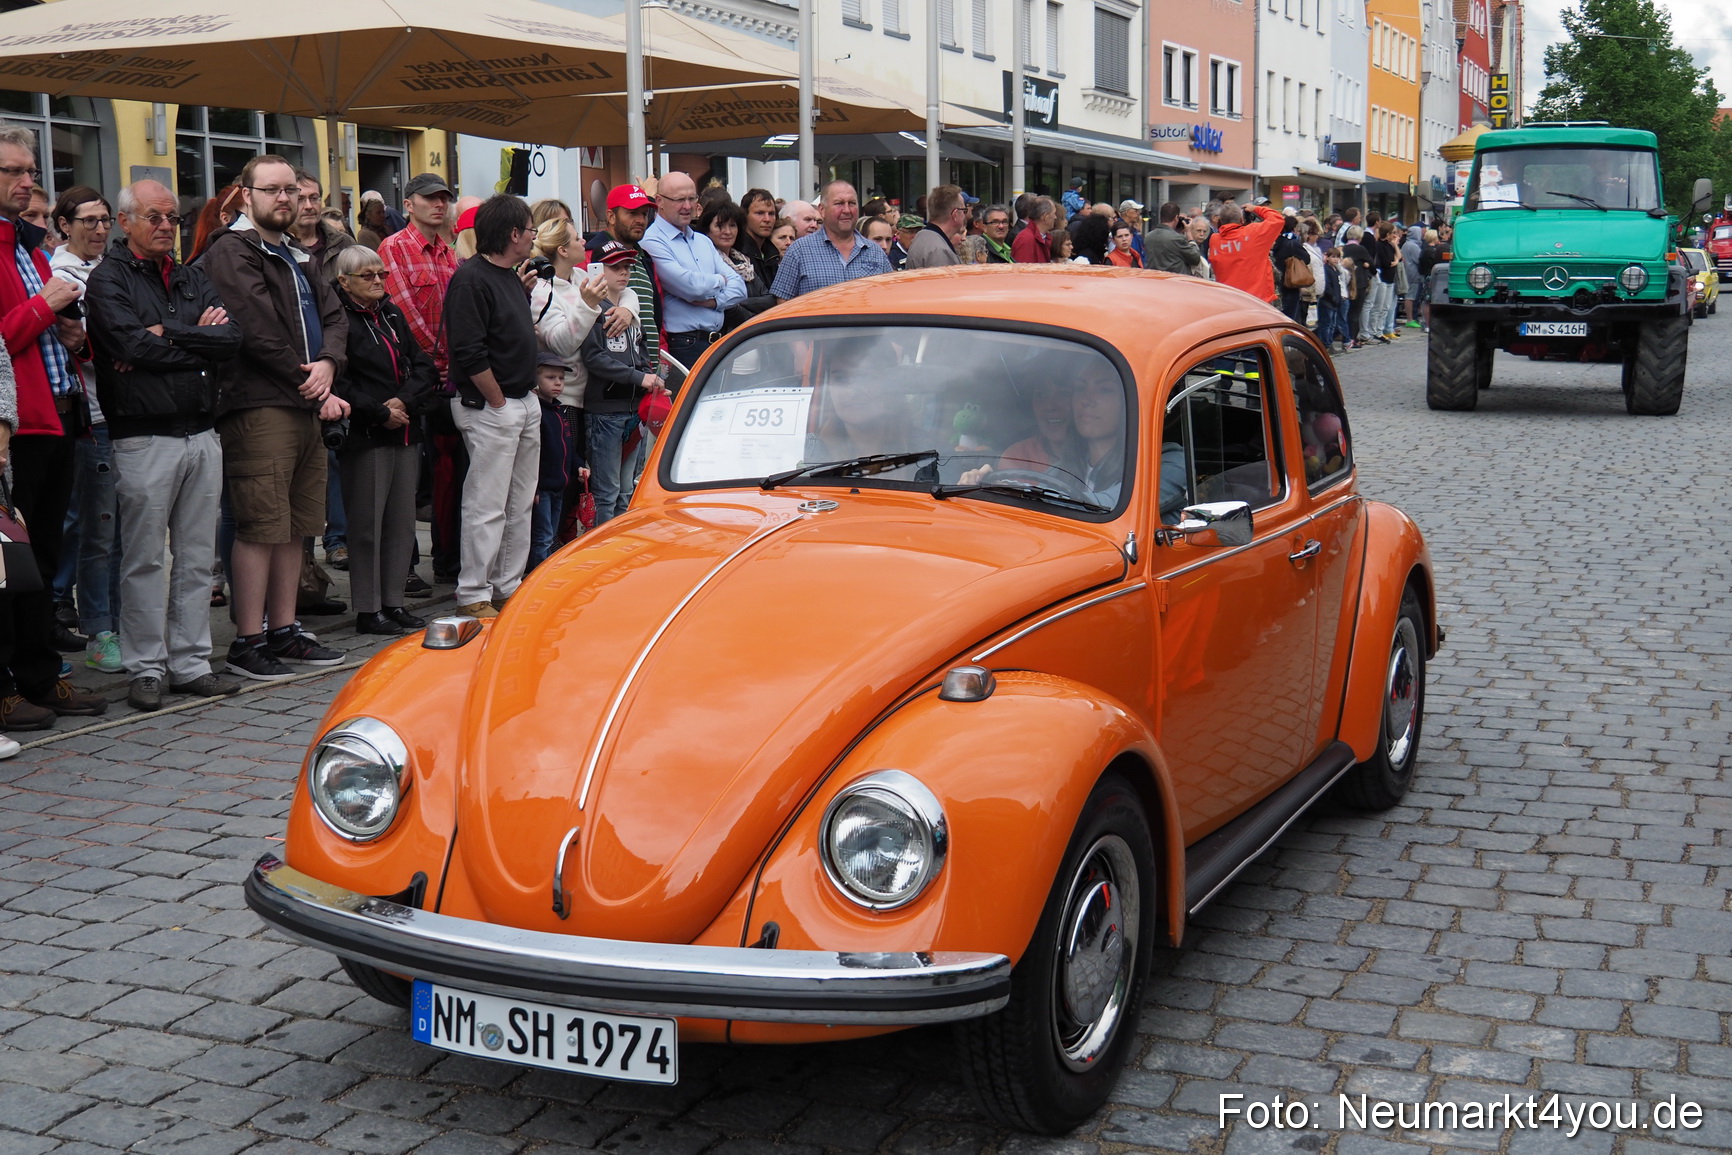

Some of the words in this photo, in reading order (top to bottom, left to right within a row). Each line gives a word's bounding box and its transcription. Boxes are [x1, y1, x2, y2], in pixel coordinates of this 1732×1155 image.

[429, 151, 441, 167] 24
[1526, 324, 1541, 334] NM
[1548, 324, 1555, 334] S
[1557, 324, 1586, 334] 416H
[744, 407, 784, 428] 593
[418, 1017, 427, 1031] D
[434, 992, 476, 1047] NM
[507, 1006, 555, 1060] SH
[566, 1016, 670, 1074] 1974
